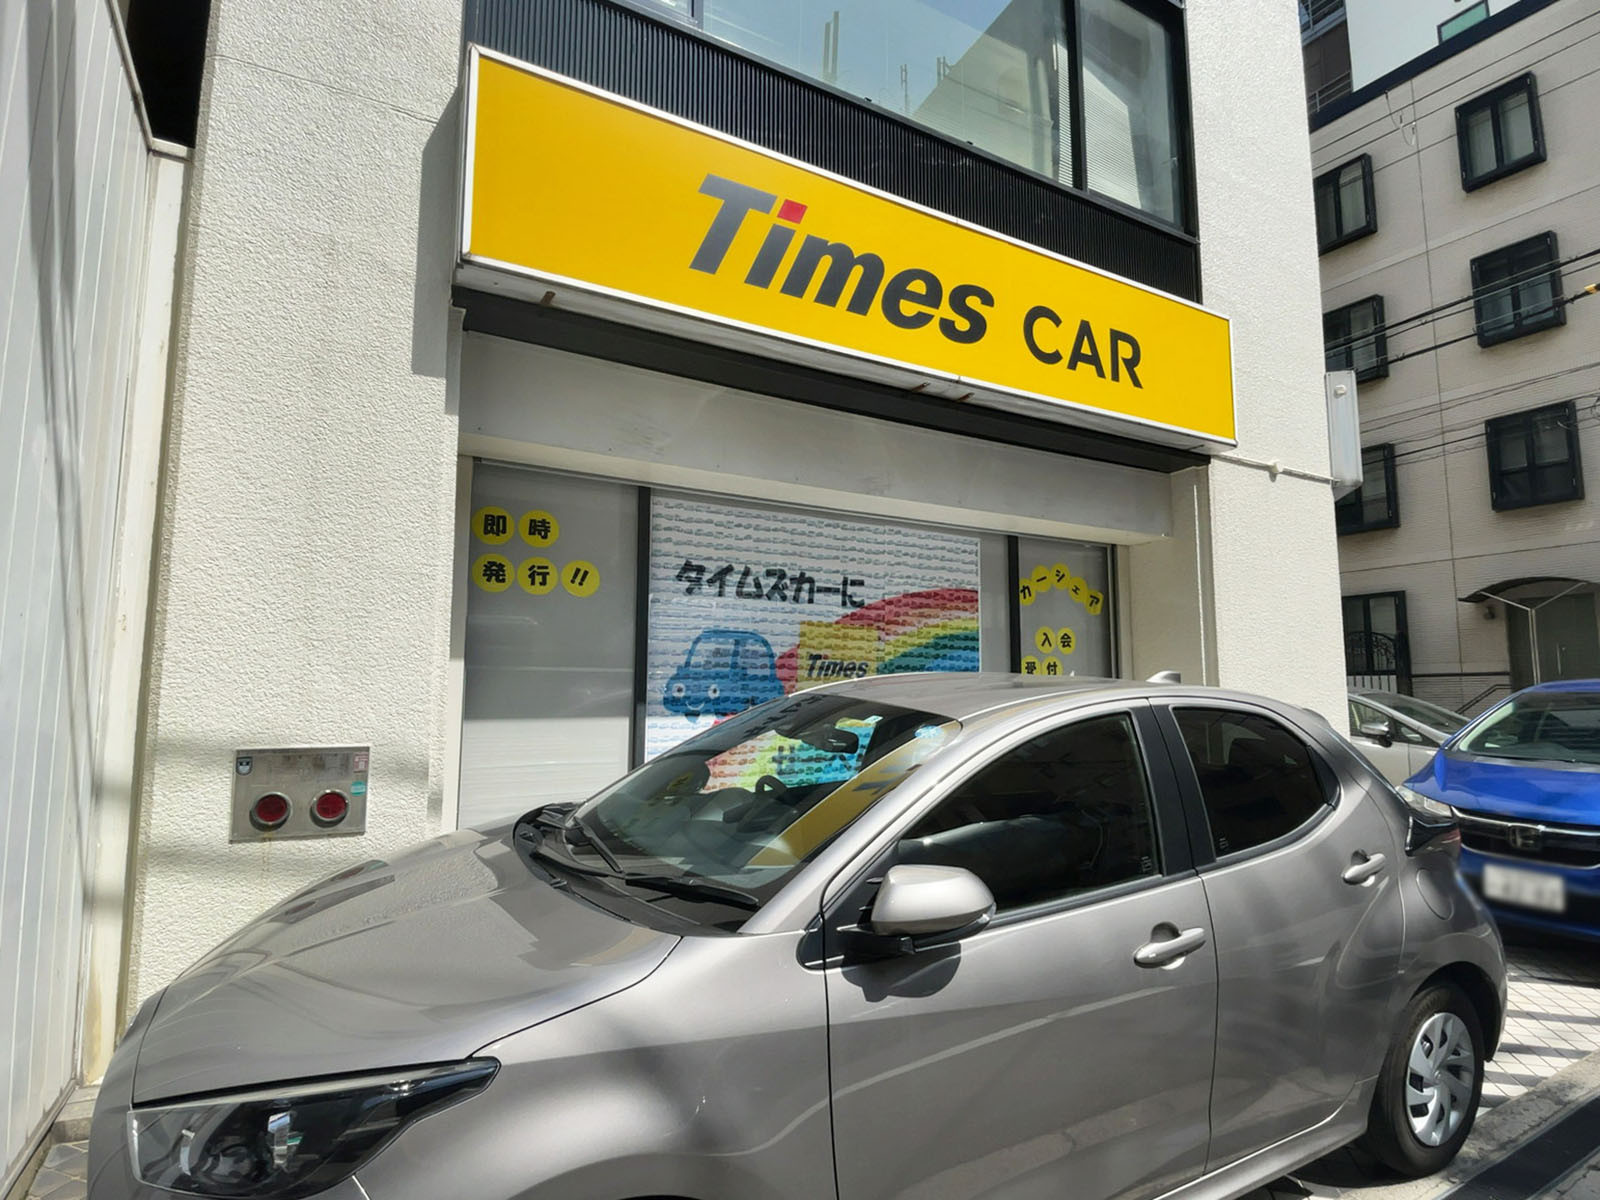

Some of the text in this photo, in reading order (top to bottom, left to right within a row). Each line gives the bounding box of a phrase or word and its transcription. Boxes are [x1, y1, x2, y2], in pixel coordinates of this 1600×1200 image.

[689, 173, 1144, 389] Times CAR
[483, 514, 551, 539] 即時
[675, 559, 865, 607] タイムズカーに
[1020, 569, 1100, 607] カーシェア
[1041, 632, 1072, 648] 入会
[807, 653, 869, 678] Times
